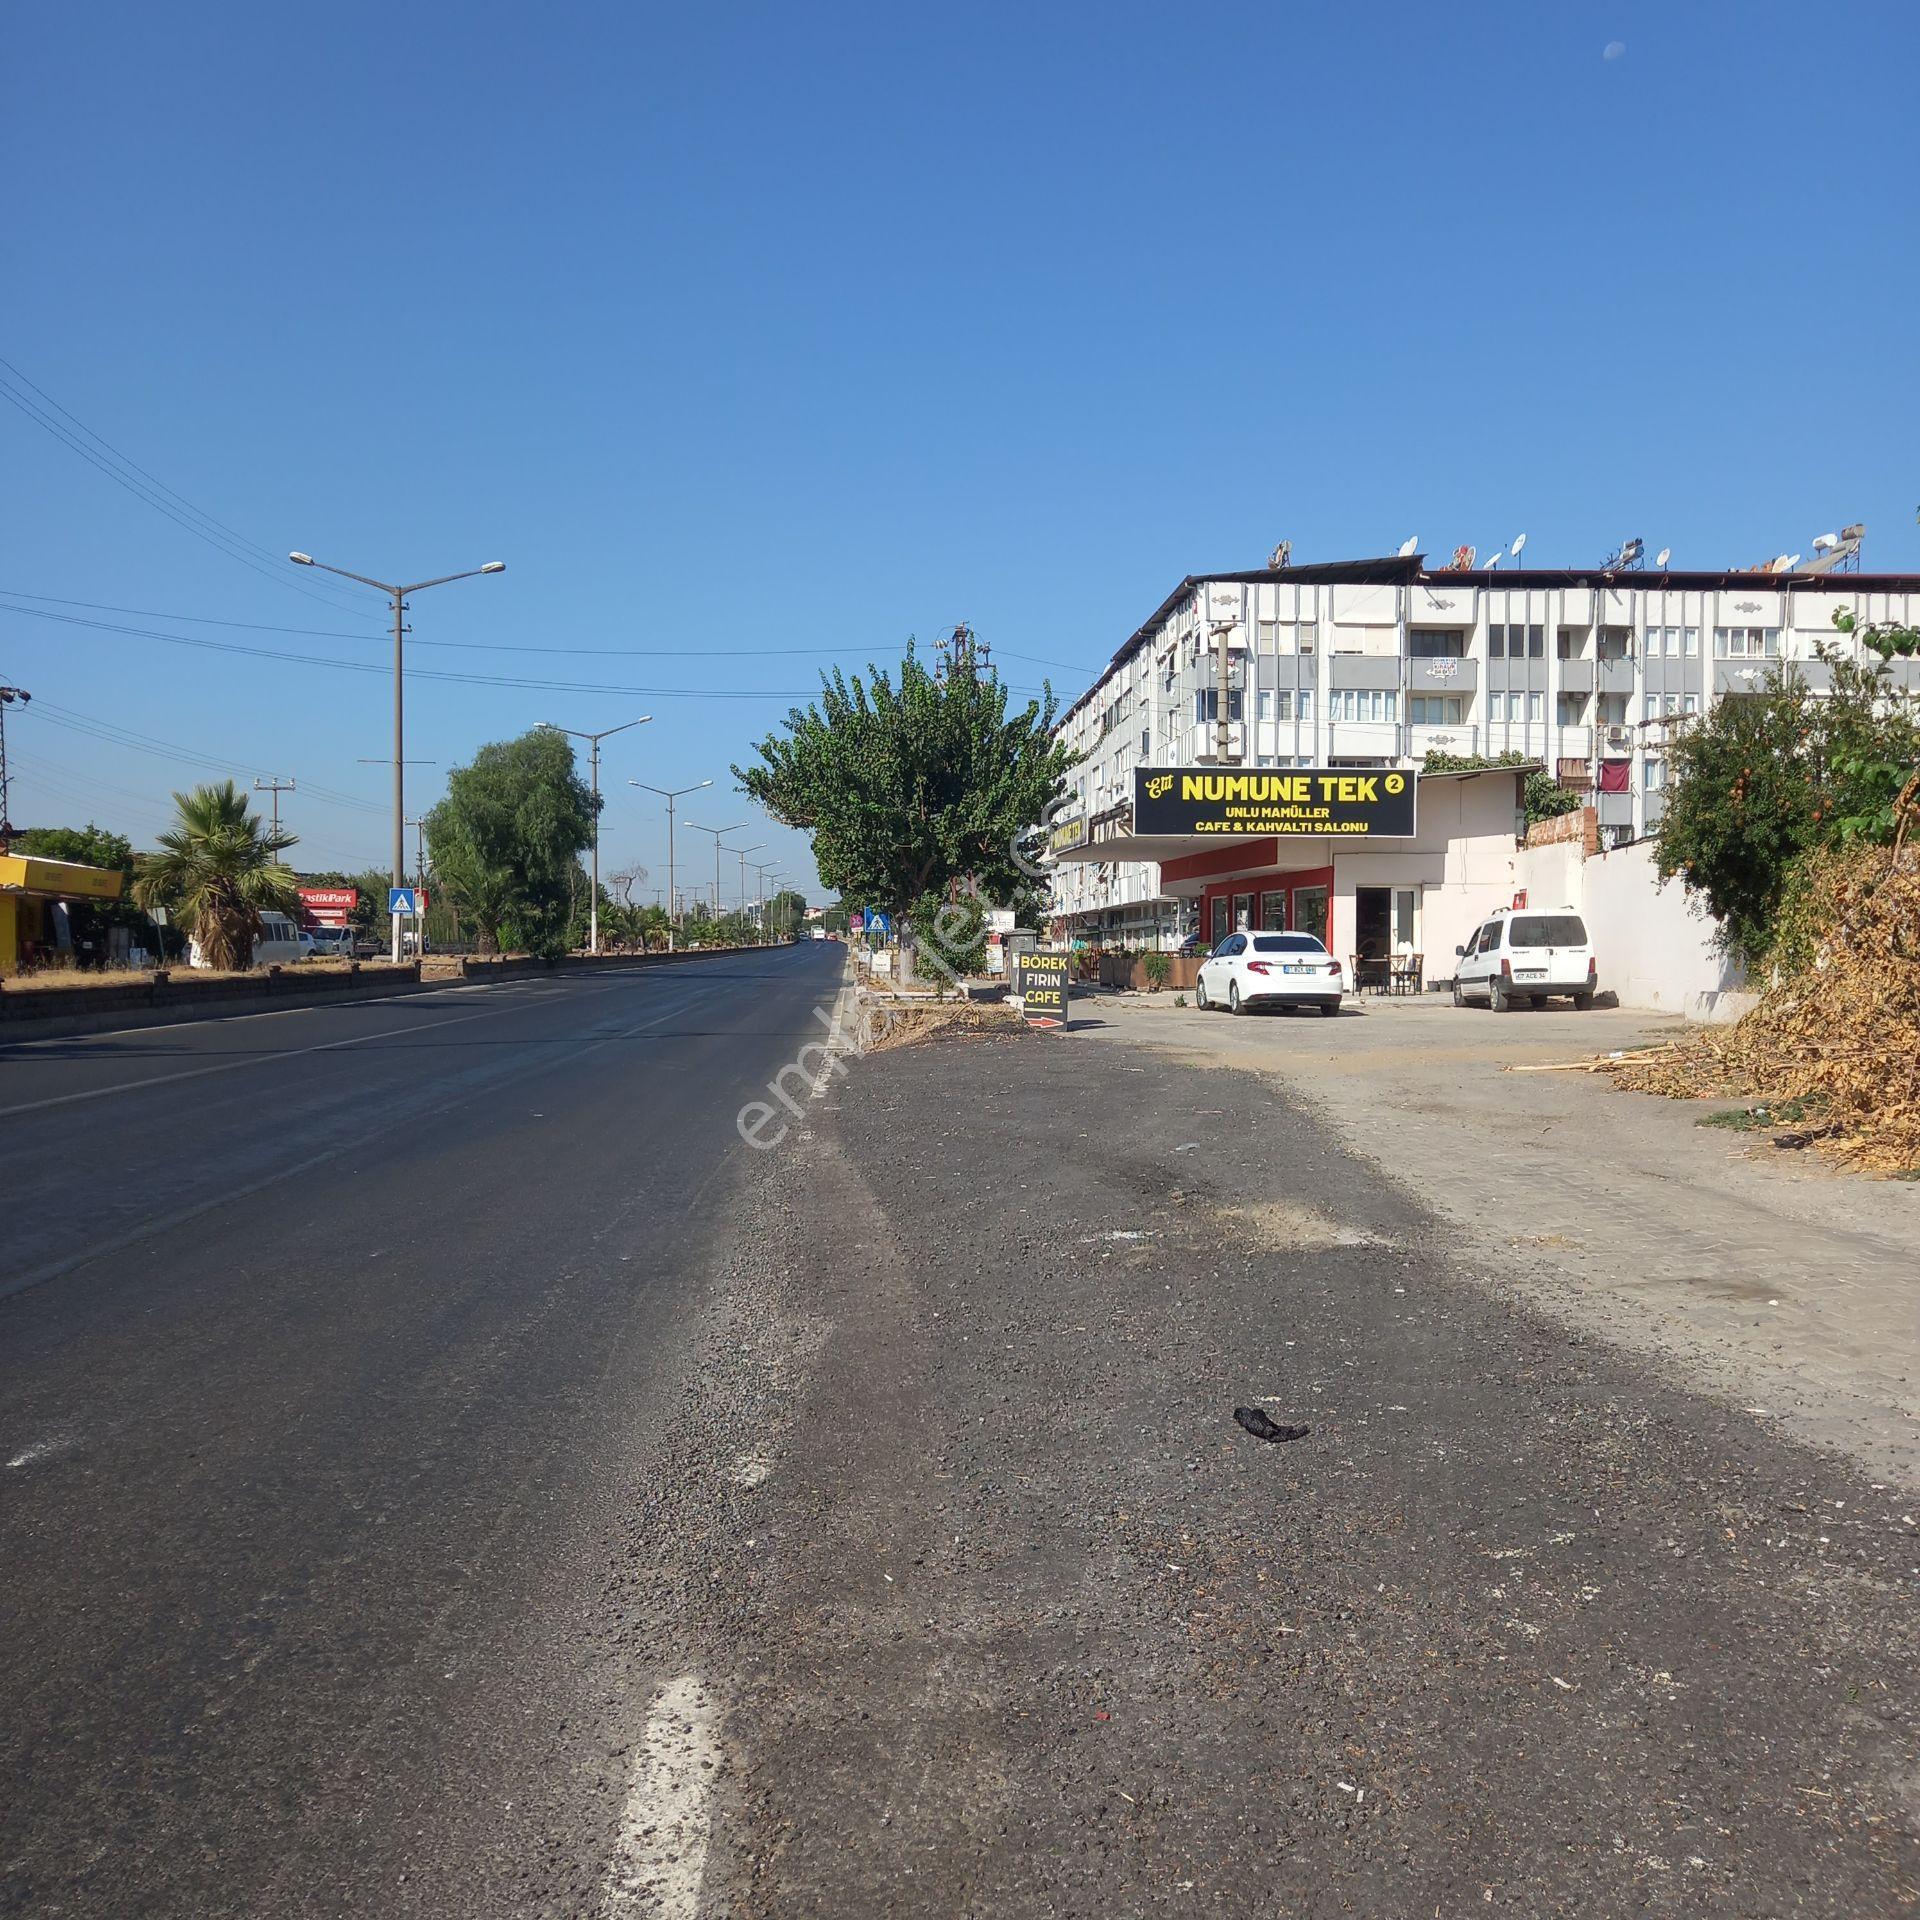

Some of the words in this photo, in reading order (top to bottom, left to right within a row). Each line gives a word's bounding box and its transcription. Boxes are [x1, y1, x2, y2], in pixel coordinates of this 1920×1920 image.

[1145, 775, 1174, 798] Elit
[1182, 776, 1311, 801] NUMUNE
[1318, 777, 1378, 801] TEK
[1226, 807, 1259, 818] UNLU
[1262, 805, 1330, 818] MAMÜLLER
[1195, 821, 1231, 831] CAFE
[1233, 822, 1243, 831] &
[1246, 822, 1312, 832] KAHVALTI
[1314, 823, 1369, 832] SALONU
[299, 893, 352, 903] astikPark
[1021, 954, 1067, 970] BÖREK
[1026, 973, 1060, 986] FIRIN
[1025, 990, 1060, 1004] CAFE
